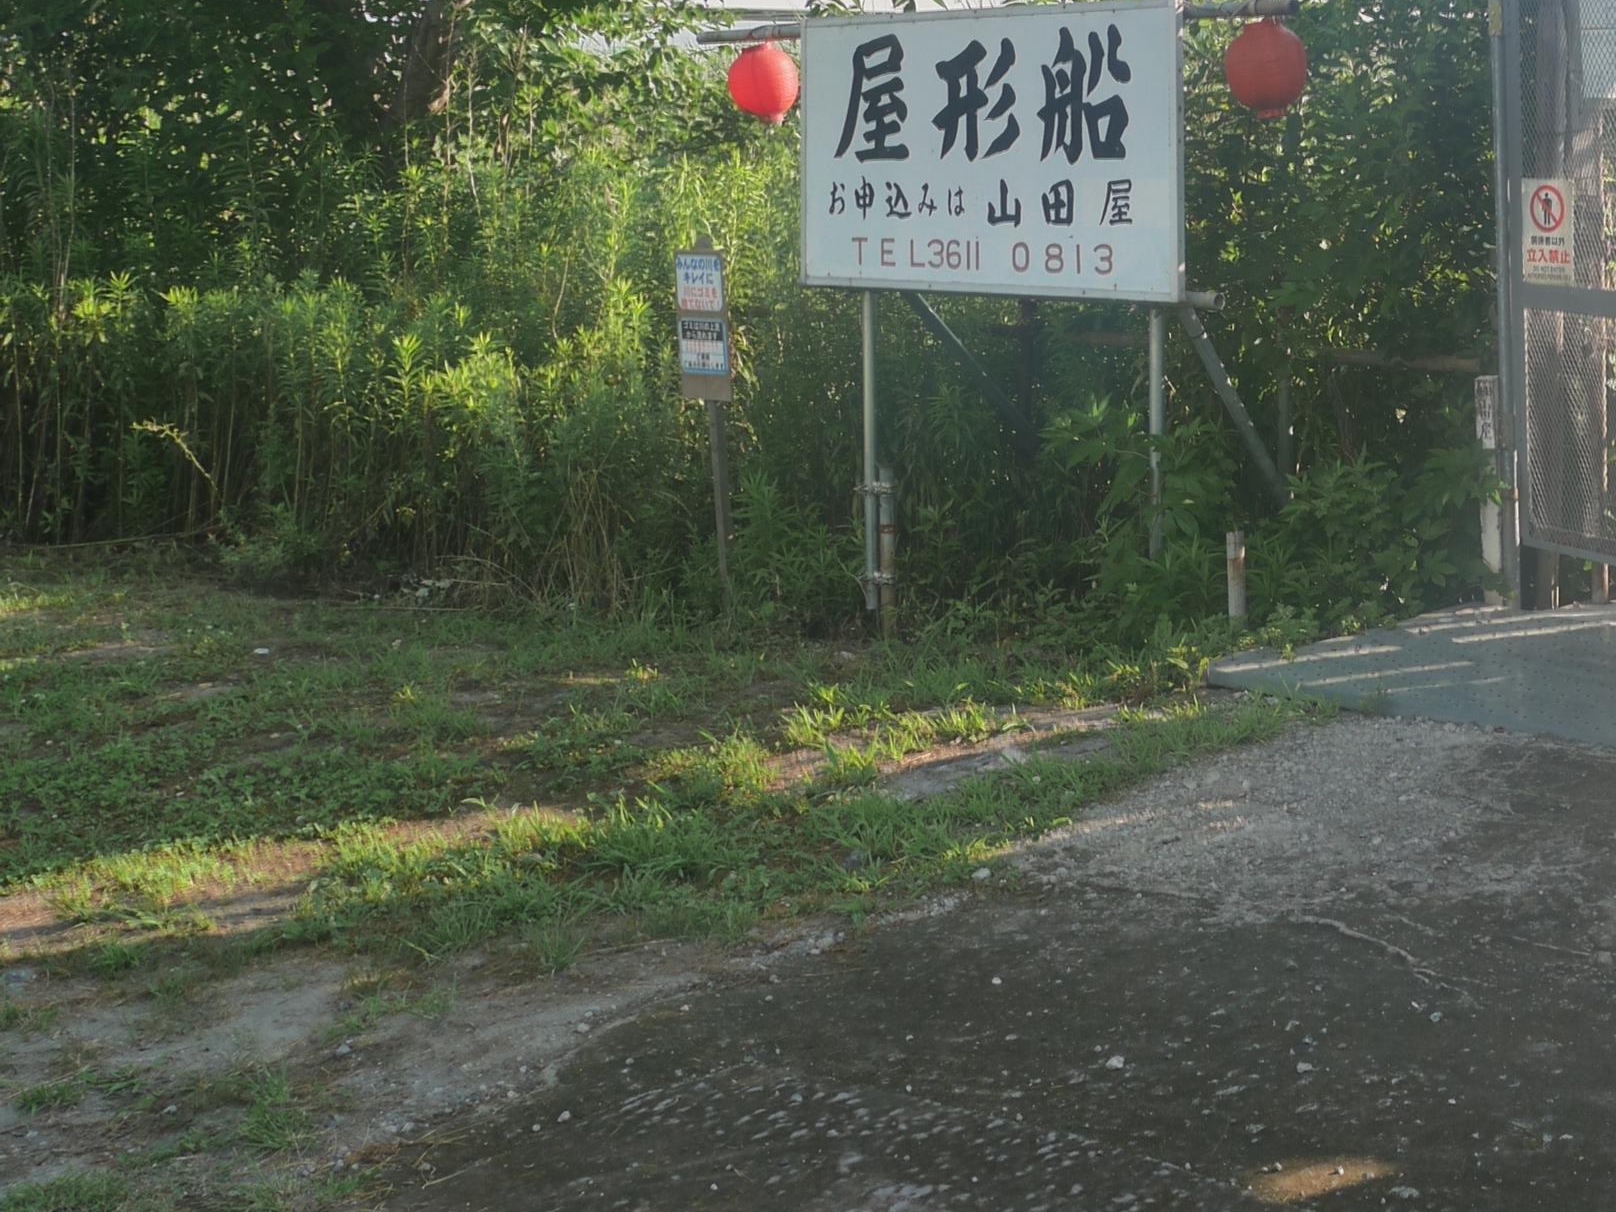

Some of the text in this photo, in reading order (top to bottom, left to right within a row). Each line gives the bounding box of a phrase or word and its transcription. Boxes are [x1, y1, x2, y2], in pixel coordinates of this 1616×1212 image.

[834, 24, 1131, 164] 屋形船
[828, 176, 1134, 228] お申込みは 山田屋
[1012, 241, 1115, 276] 0813
[1527, 248, 1571, 264] 立入禁止
[684, 271, 714, 285] キレイに
